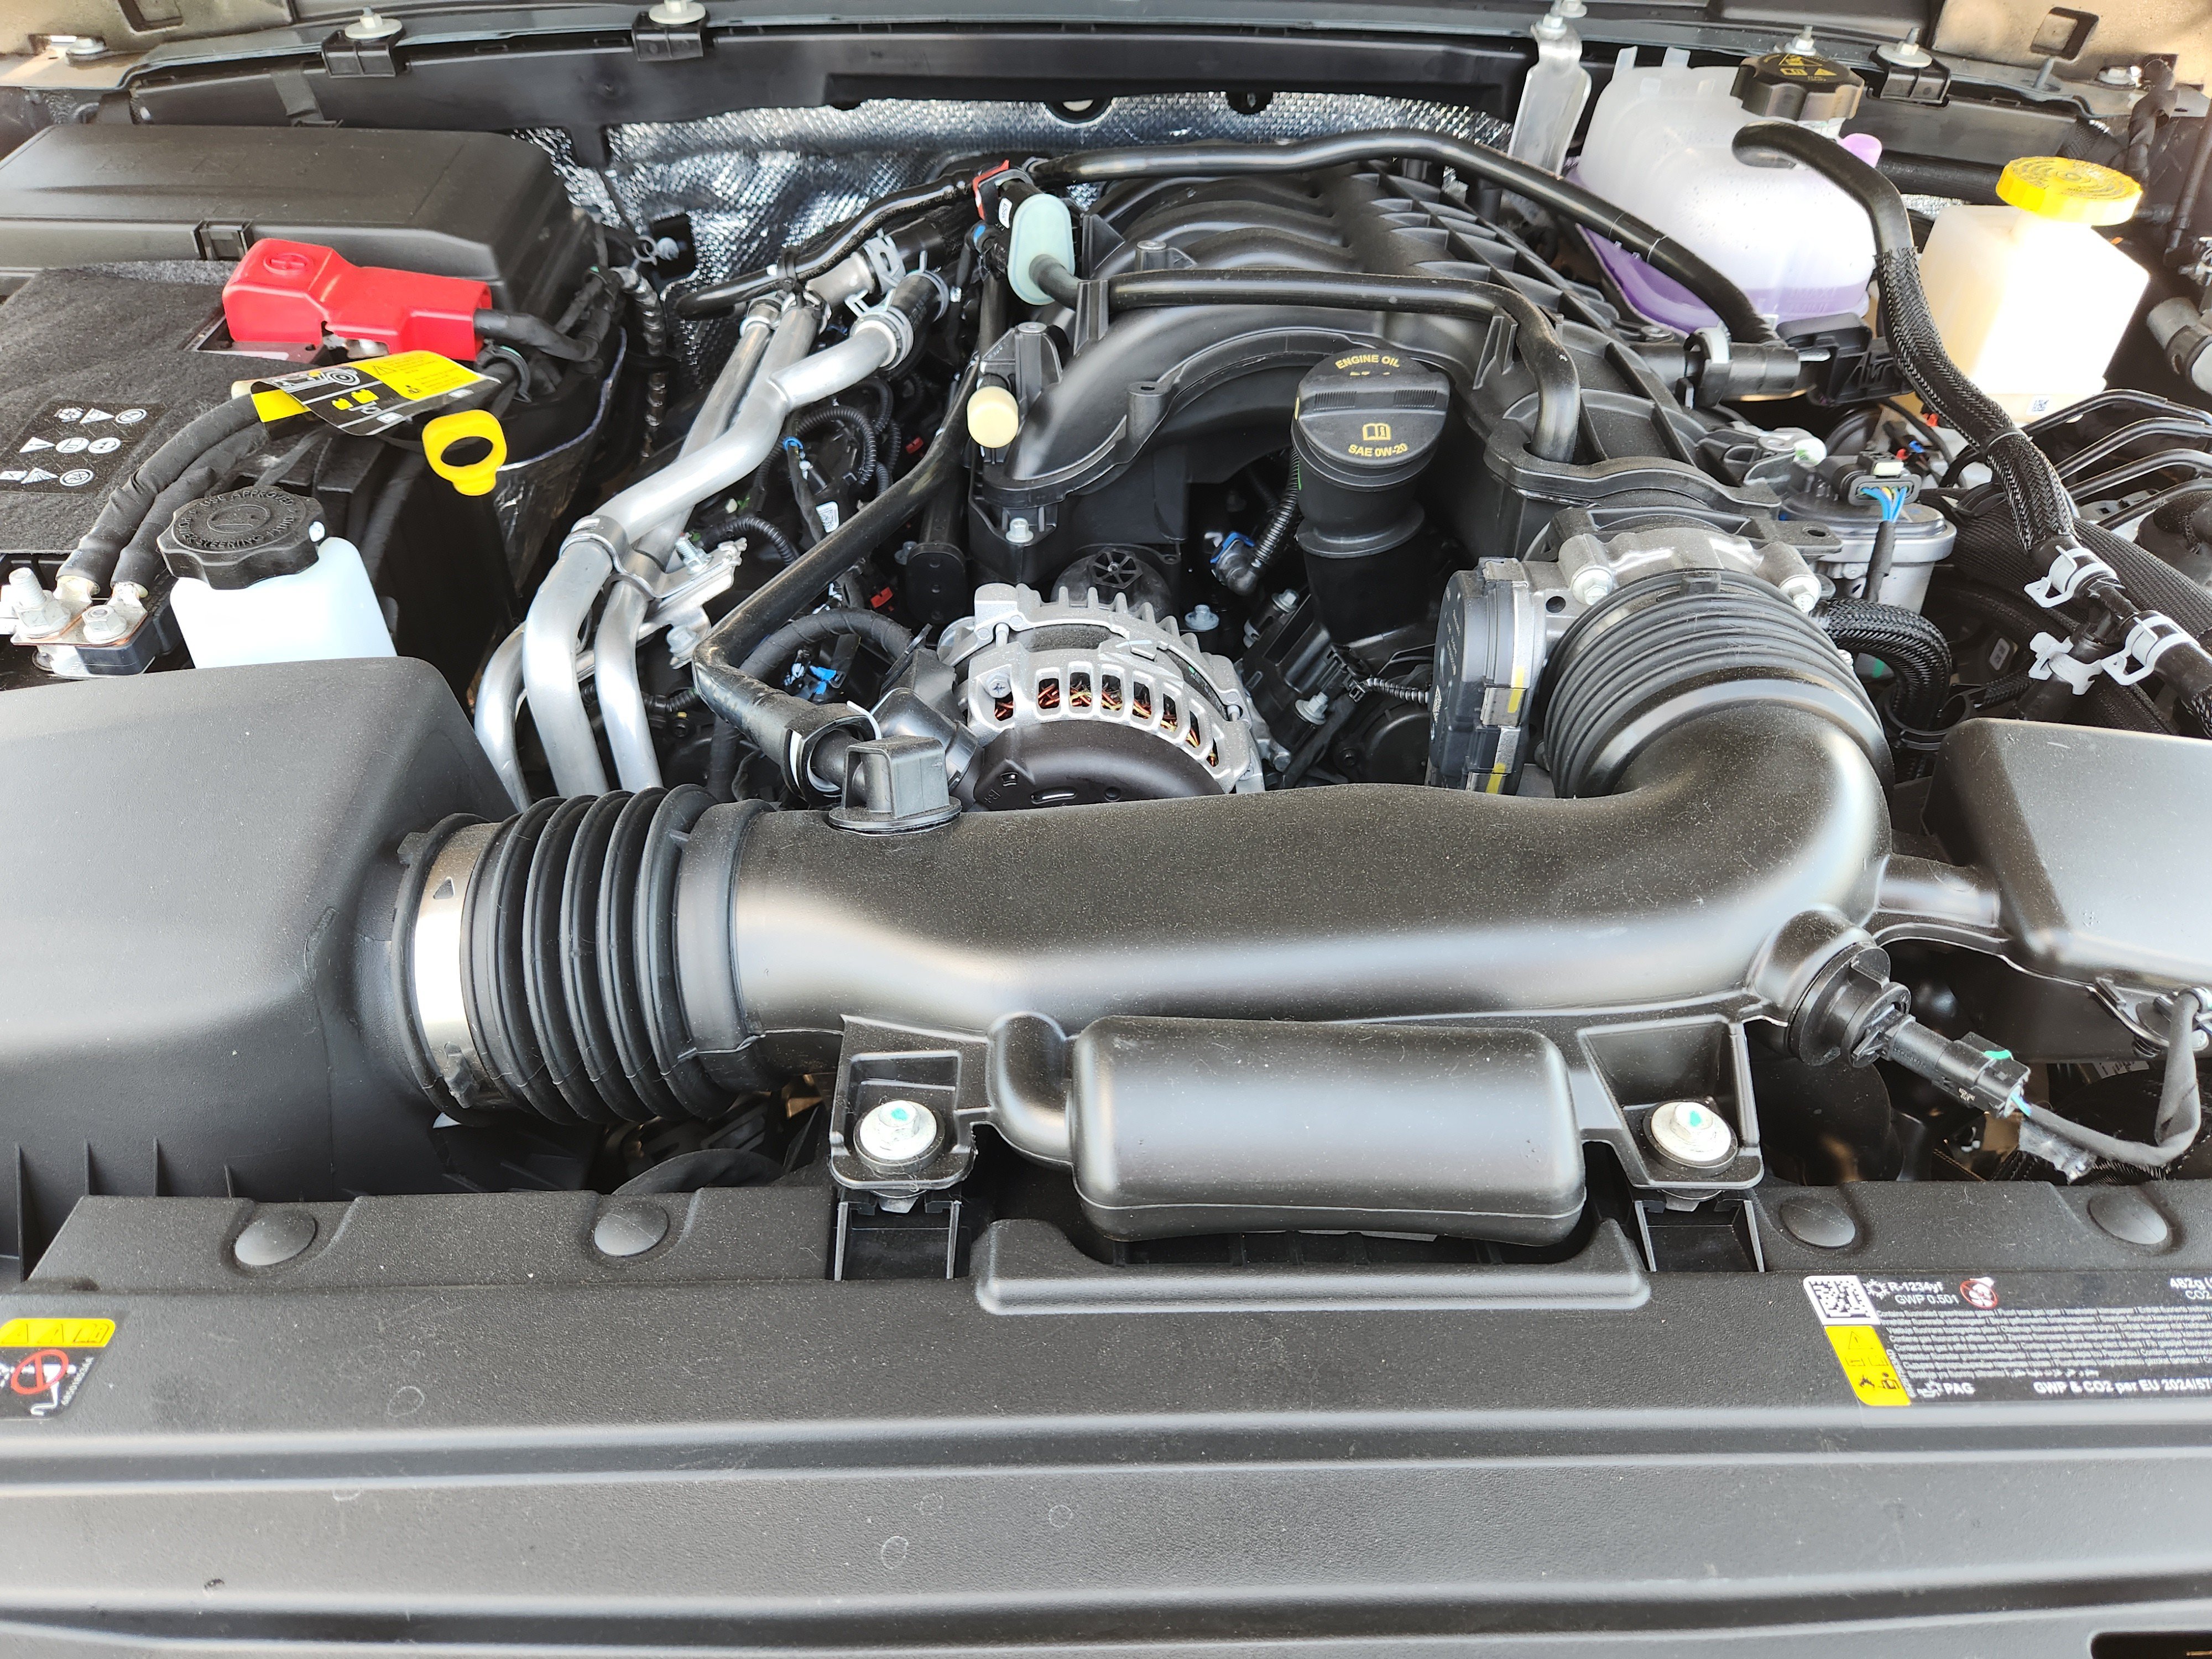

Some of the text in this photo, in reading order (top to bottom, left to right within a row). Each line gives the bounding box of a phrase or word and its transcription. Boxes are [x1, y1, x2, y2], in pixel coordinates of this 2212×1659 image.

[1335, 354, 1400, 369] ENGINE OIL
[1348, 443, 1408, 457] SAE 0W-20
[200, 490, 294, 507] USE APPROVED
[1887, 1281, 1944, 1293] R-1234yf
[2170, 1277, 2205, 1290] 482g
[1895, 1294, 1960, 1305] GWP 0.501
[2185, 1290, 2212, 1300] CO2
[1942, 1383, 1976, 1395] PAG
[2033, 1380, 2068, 1394] GWP
[2070, 1381, 2083, 1394] &
[2082, 1380, 2114, 1394] CO2
[2114, 1381, 2139, 1395] per
[2138, 1379, 2160, 1391] EU
